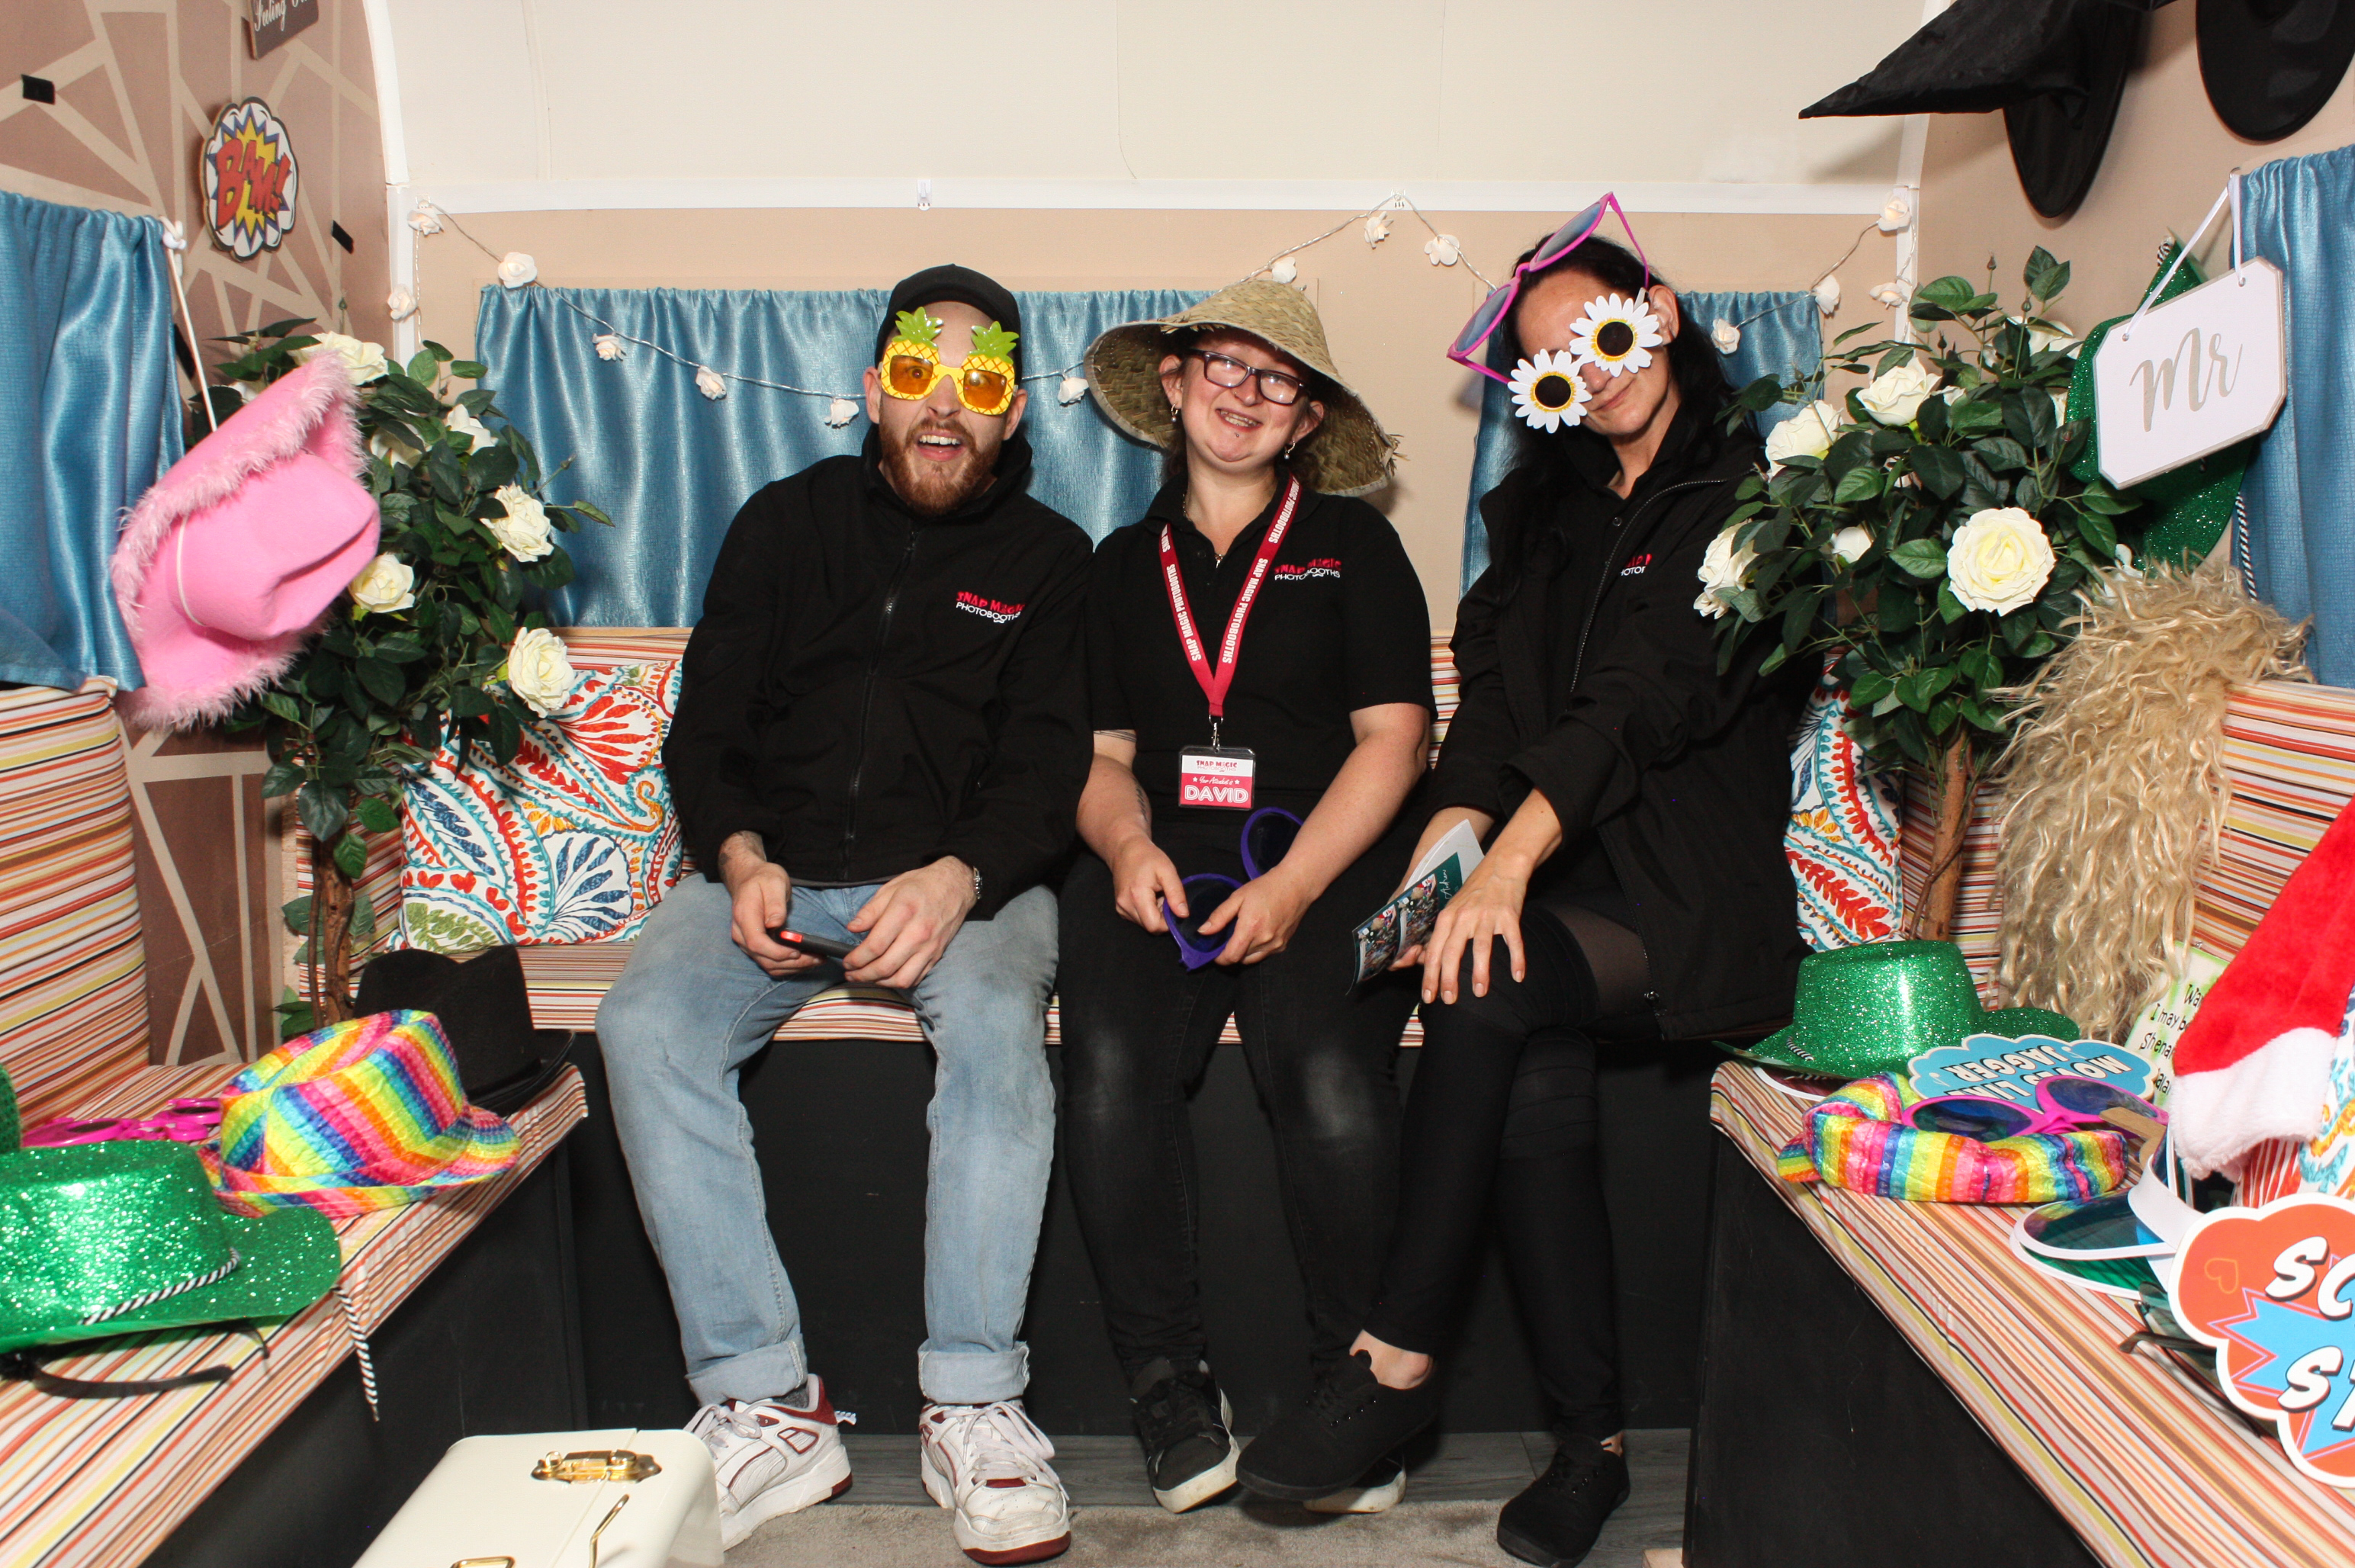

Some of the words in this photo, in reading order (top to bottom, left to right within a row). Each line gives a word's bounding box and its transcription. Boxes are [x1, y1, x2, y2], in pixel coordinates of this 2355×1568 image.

[217, 137, 291, 230] BAM!
[2128, 327, 2244, 432] Mr
[1268, 496, 1296, 544] PHOTOBOOTHS
[1253, 557, 1268, 578] SNAP
[956, 591, 988, 608] SNAP
[1166, 563, 1186, 612] PHOTOBOOTHS
[1241, 577, 1260, 602] MAGIC
[1177, 611, 1194, 638] MAGIC
[1222, 602, 1248, 664] PHOTOBOOTHS
[1185, 638, 1203, 662] SNAP
[1184, 784, 1249, 804] DAVID
[2150, 1003, 2161, 1021] I
[2157, 1008, 2180, 1030] may
[1939, 1045, 2071, 1083] JAGGER
